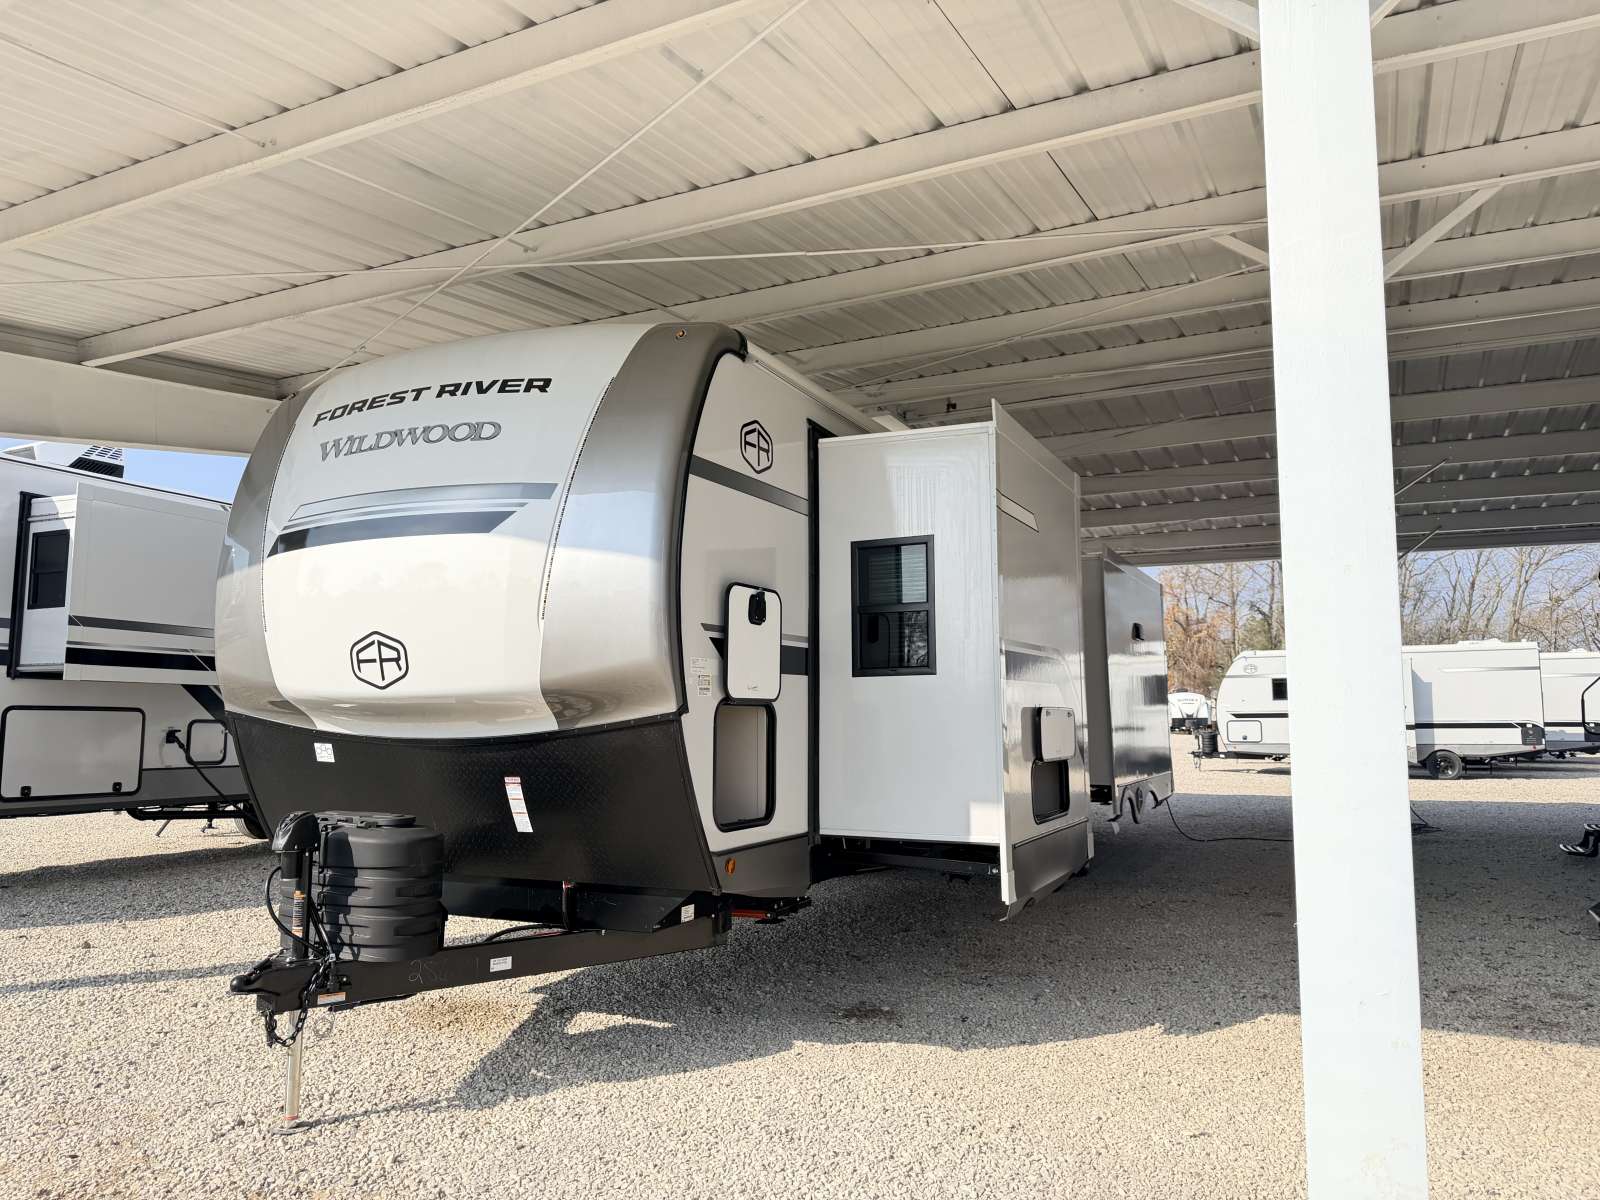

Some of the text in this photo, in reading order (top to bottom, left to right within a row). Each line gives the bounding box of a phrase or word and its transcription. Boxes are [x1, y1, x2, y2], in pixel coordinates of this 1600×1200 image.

[313, 378, 552, 427] FOREST RIVER
[320, 421, 501, 462] WILDWOOD
[743, 427, 771, 467] FR
[355, 639, 403, 681] FR
